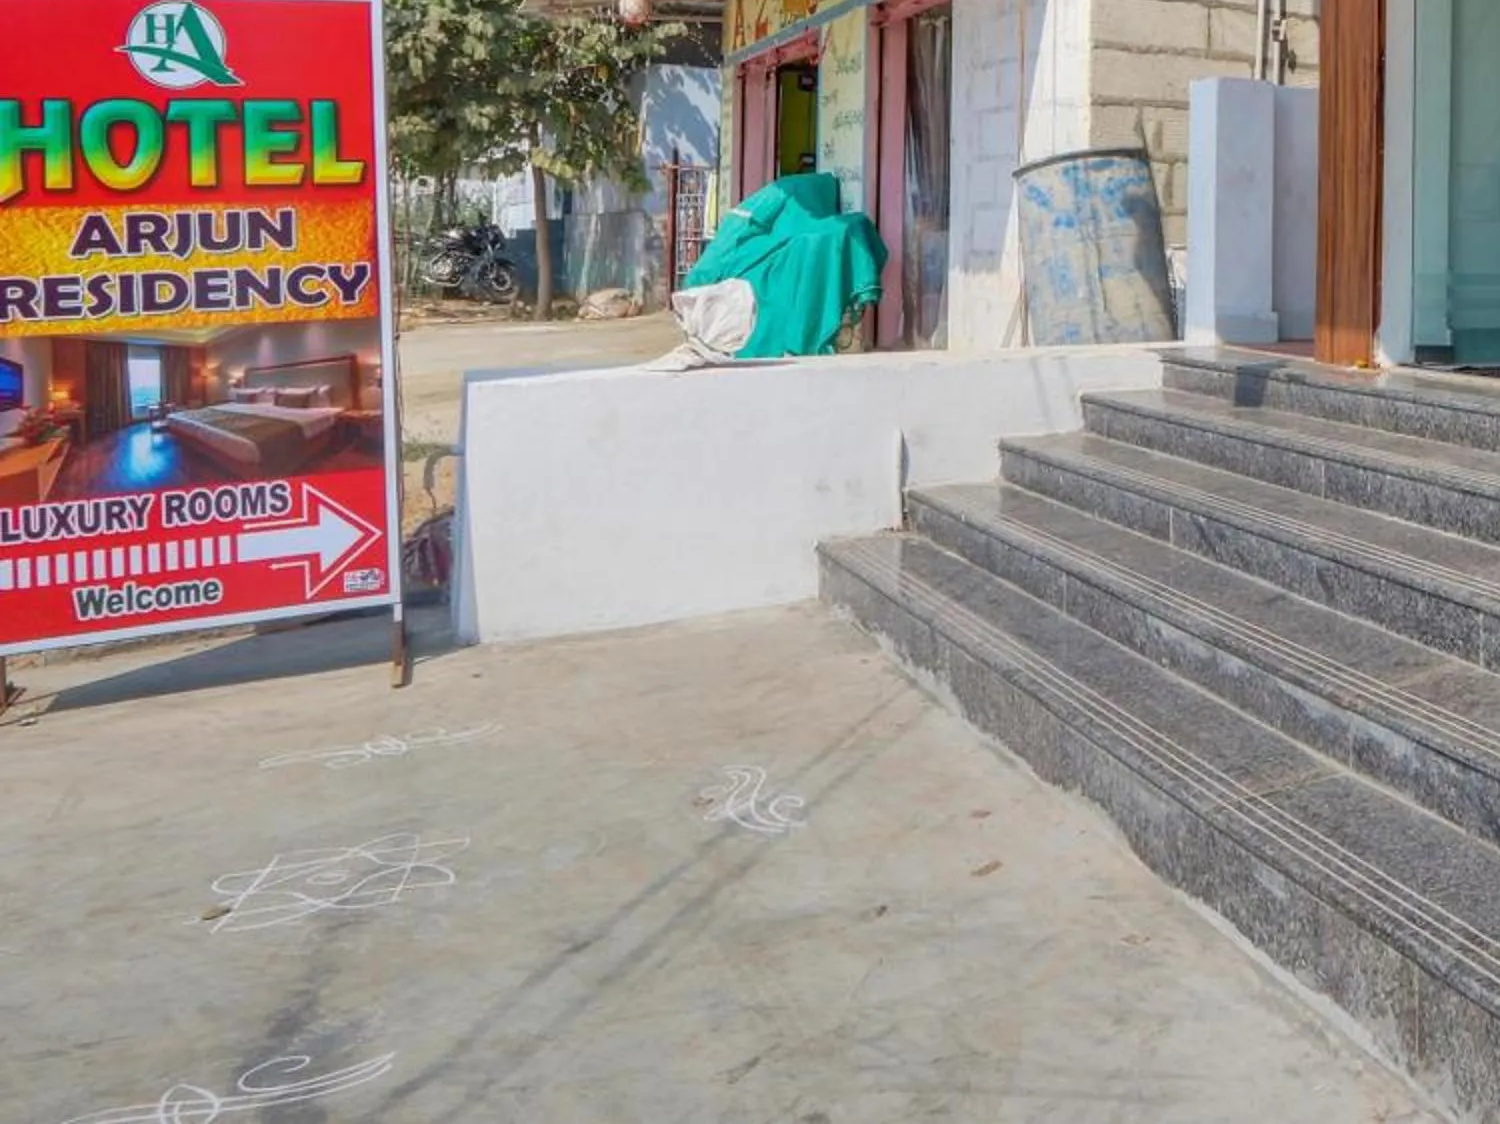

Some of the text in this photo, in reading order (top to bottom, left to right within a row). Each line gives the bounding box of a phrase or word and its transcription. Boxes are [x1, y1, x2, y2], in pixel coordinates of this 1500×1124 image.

[0, 98, 366, 204] HOTEL
[70, 209, 295, 260] ARJUN
[0, 263, 370, 322] RESIDENCY
[0, 482, 291, 543] LUXURY ROOMS
[75, 579, 221, 620] Welcome
